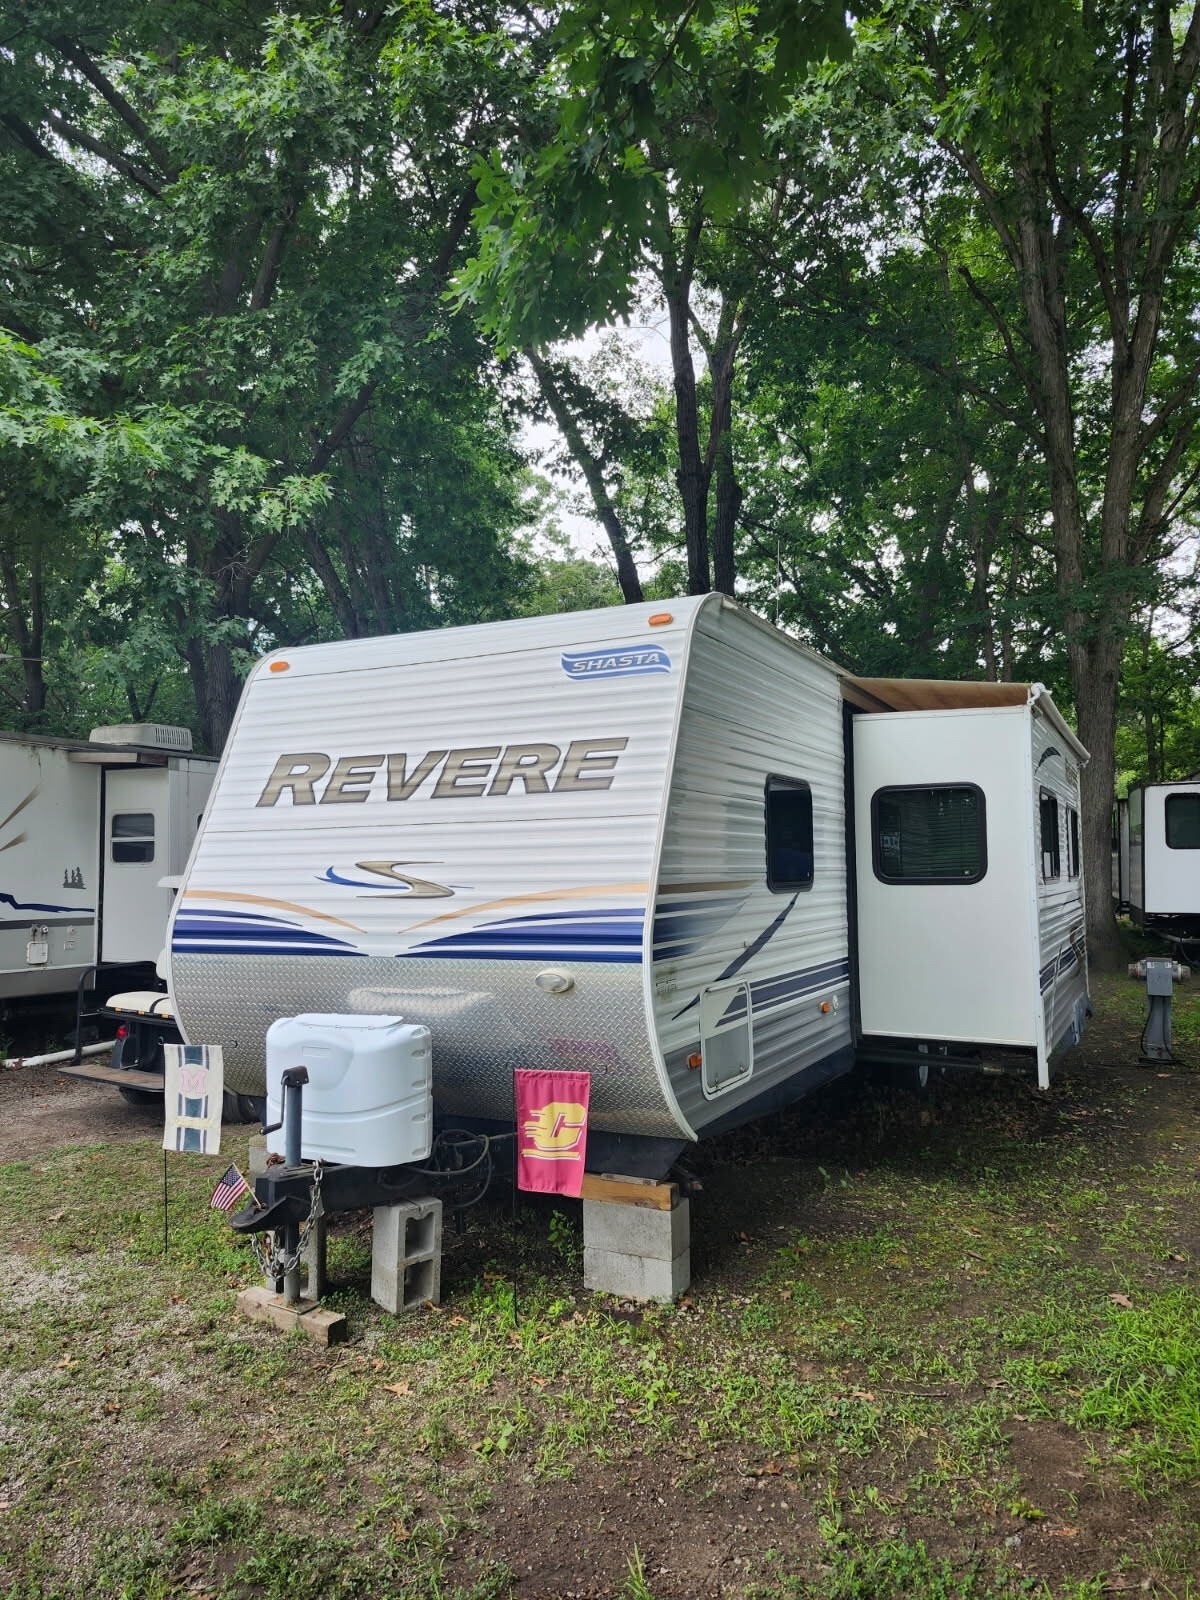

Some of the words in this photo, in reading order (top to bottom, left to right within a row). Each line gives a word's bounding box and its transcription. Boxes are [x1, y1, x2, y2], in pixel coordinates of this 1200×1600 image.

[571, 652, 661, 673] SHASTA
[256, 736, 629, 808] REVERE
[181, 1069, 208, 1093] M
[524, 1101, 586, 1151] C
